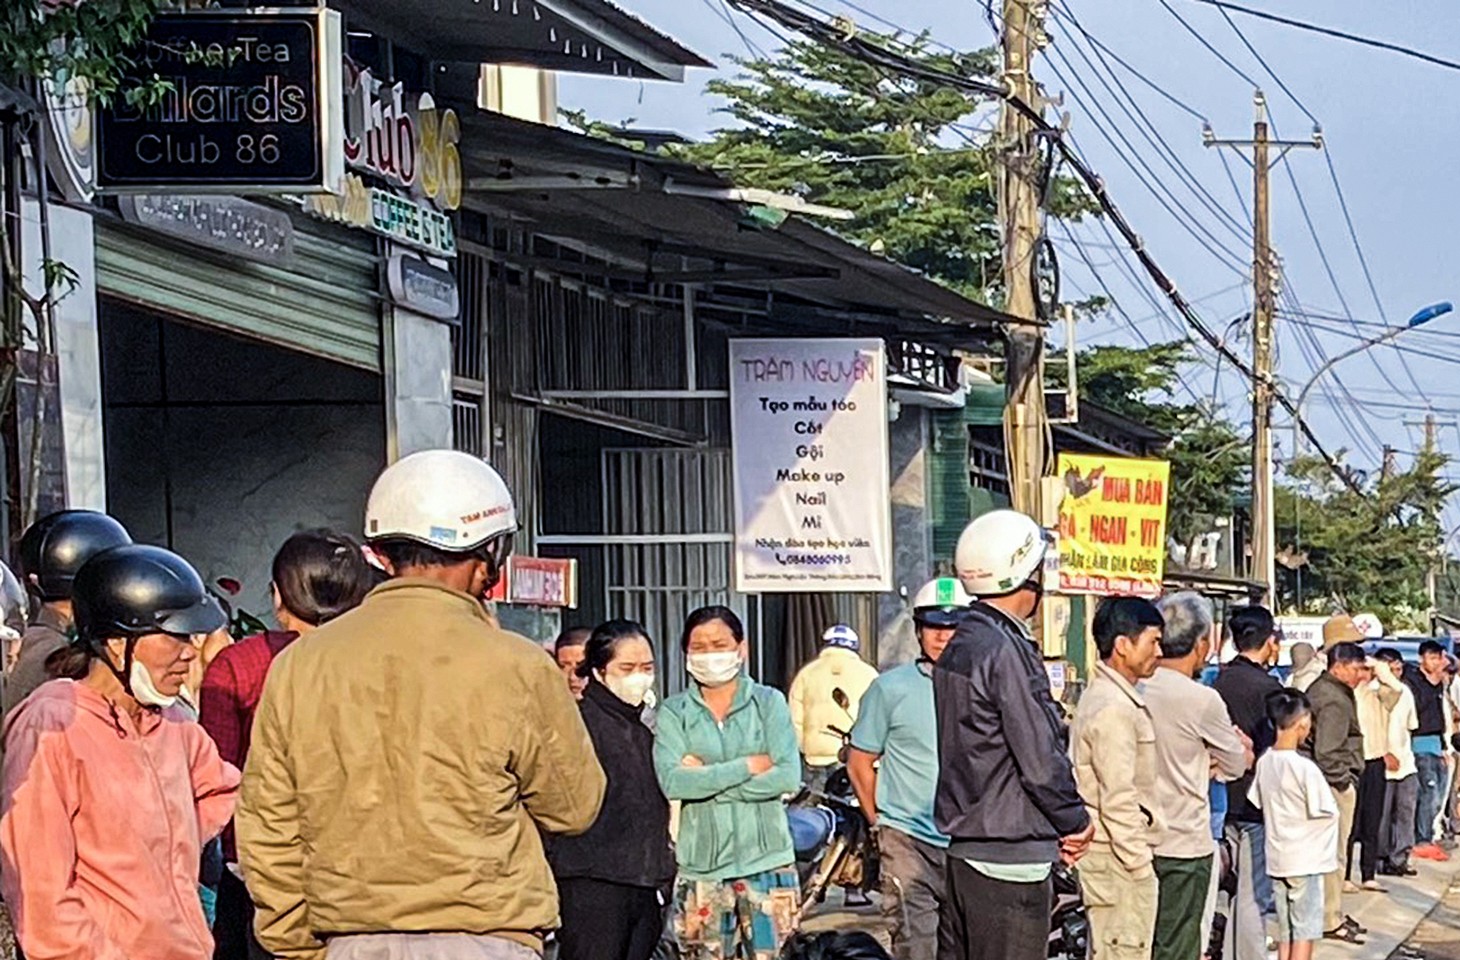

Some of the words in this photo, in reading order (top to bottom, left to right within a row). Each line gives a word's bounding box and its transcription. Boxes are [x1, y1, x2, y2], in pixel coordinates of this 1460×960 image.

[237, 37, 290, 62] Tea
[136, 134, 220, 163] Club
[236, 134, 280, 163] 86
[417, 92, 461, 211] 86
[371, 188, 420, 242] COFFEE
[759, 397, 789, 414] Tạo
[793, 396, 827, 411] mẫu
[832, 397, 857, 411] tóc
[796, 444, 823, 461] Gội
[776, 467, 820, 482] Make
[825, 472, 845, 485] up
[1102, 476, 1130, 503] MUA
[1135, 473, 1162, 506] BÁN
[796, 492, 826, 505] Nail
[1090, 514, 1127, 546] NGAN
